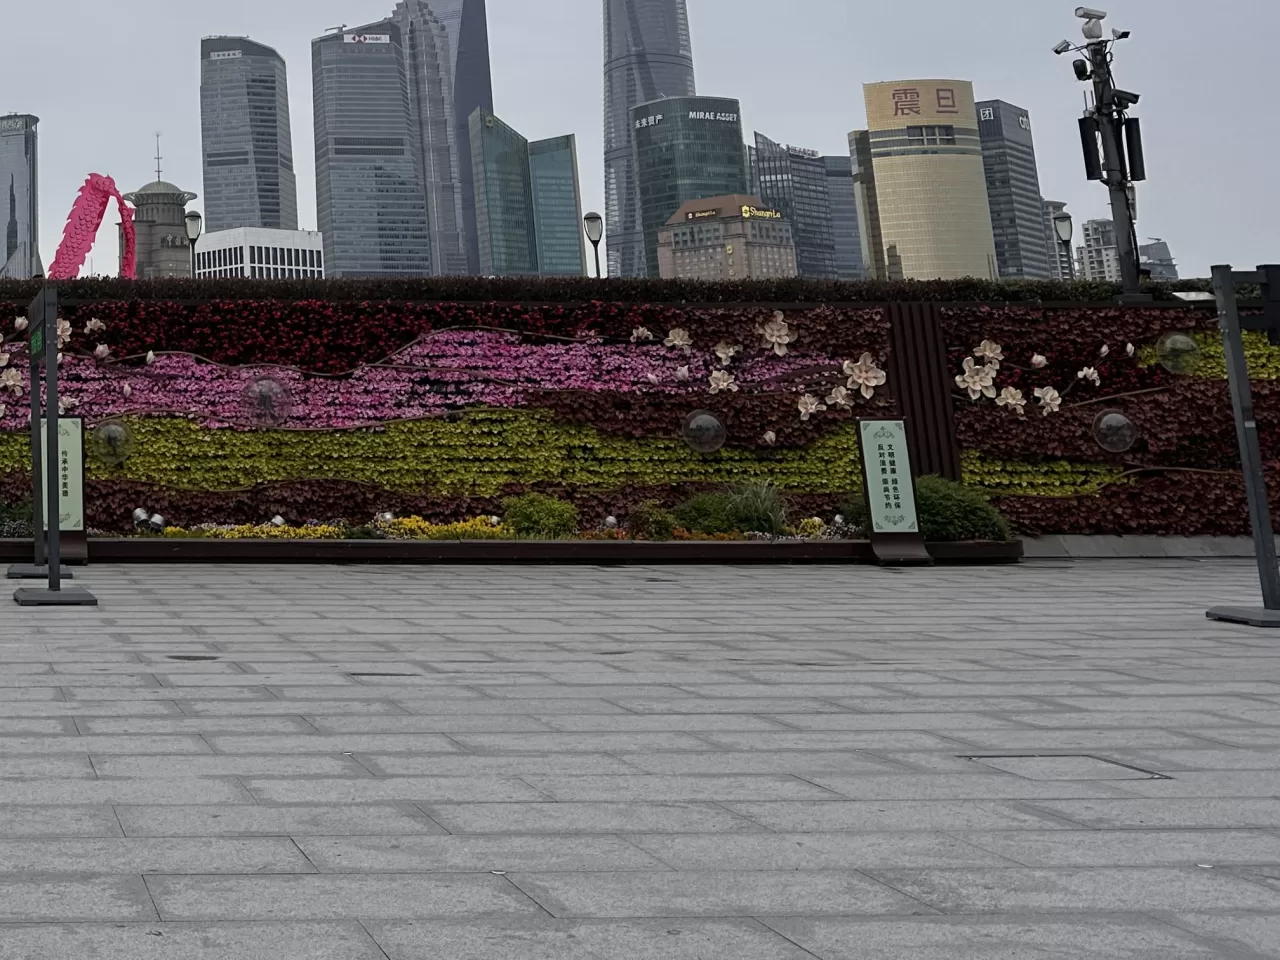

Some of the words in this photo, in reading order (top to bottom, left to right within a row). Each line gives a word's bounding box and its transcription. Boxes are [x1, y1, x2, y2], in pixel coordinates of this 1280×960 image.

[688, 111, 715, 120] MIRAE
[716, 112, 738, 122] ASSET
[892, 88, 958, 116] 震旦
[980, 107, 994, 121] 团
[61, 450, 69, 497] 传承中华美德
[877, 443, 888, 475] 反对浪费
[887, 443, 898, 475] 文明健康
[881, 477, 892, 509] 崇尚节约
[891, 477, 902, 509] 绿色环保
